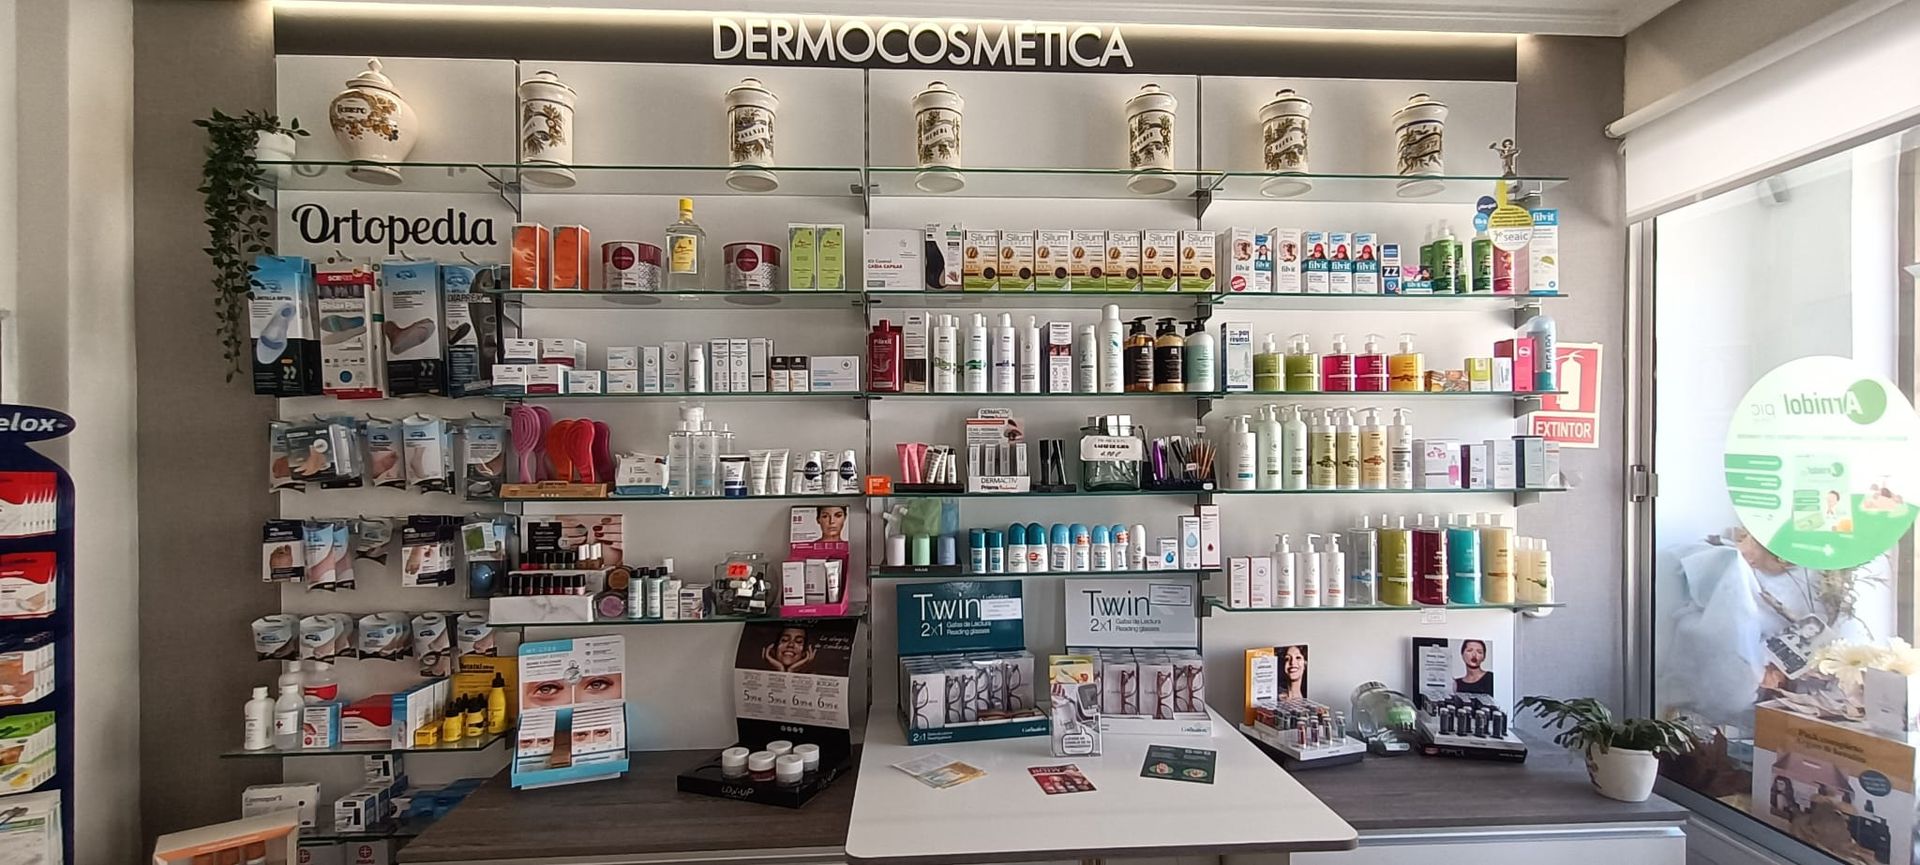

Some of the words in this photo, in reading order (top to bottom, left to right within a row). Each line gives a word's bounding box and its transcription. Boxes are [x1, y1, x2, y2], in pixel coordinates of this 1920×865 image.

[291, 203, 496, 255] Ortopedia
[1536, 421, 1592, 438] EXTINTOR
[912, 592, 981, 621] Twin
[1082, 590, 1150, 616] Twin
[921, 622, 943, 637] 2x1
[1090, 618, 1112, 632] 2x1
